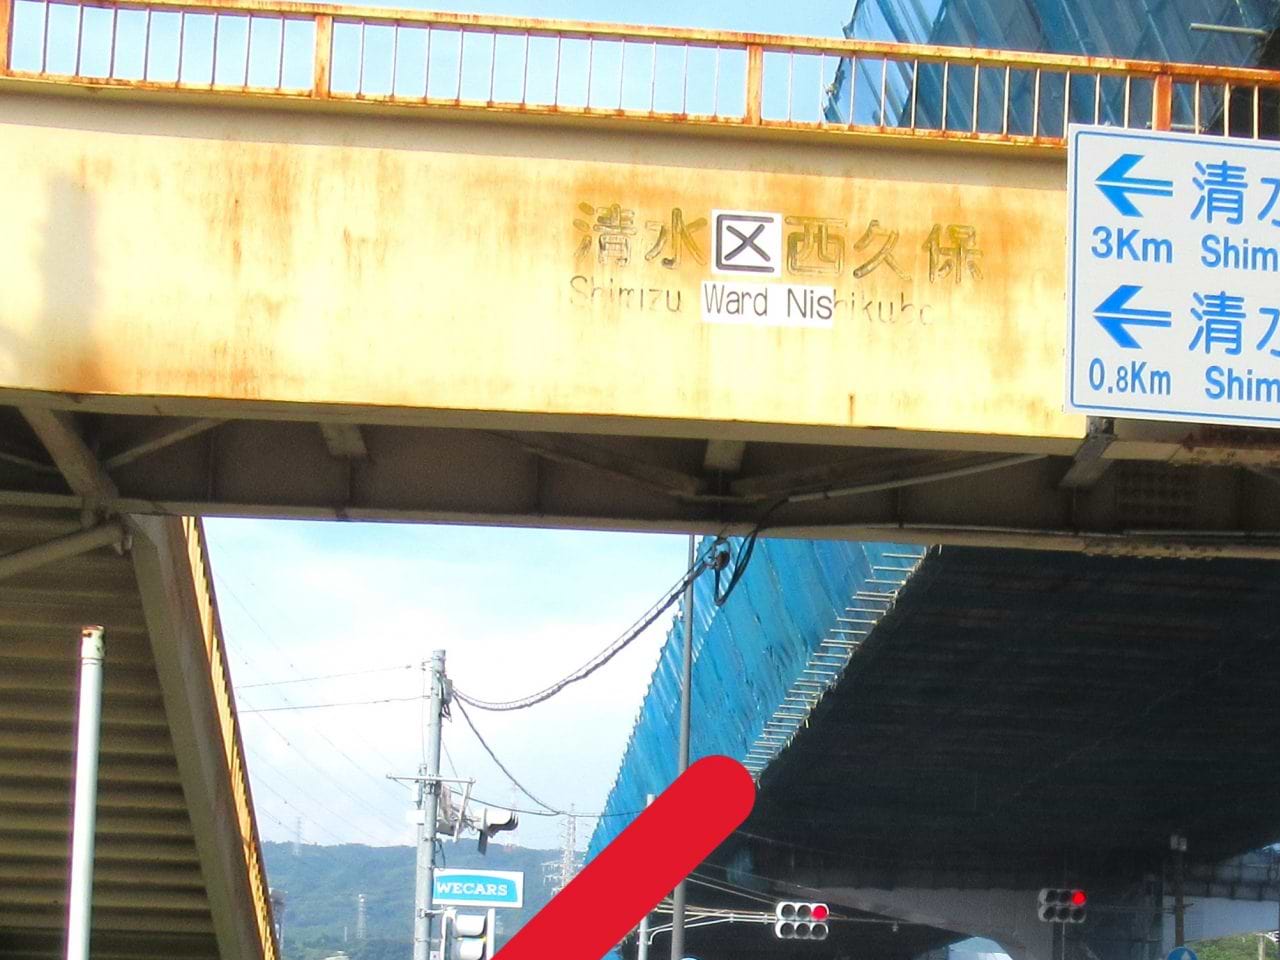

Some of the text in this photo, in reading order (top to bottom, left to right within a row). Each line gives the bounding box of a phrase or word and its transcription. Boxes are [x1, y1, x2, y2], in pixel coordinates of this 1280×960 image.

[1091, 226, 1173, 264] 3Km
[703, 282, 768, 318] Ward
[1088, 357, 1171, 396] 0.8Km
[436, 881, 509, 897] WECARS
